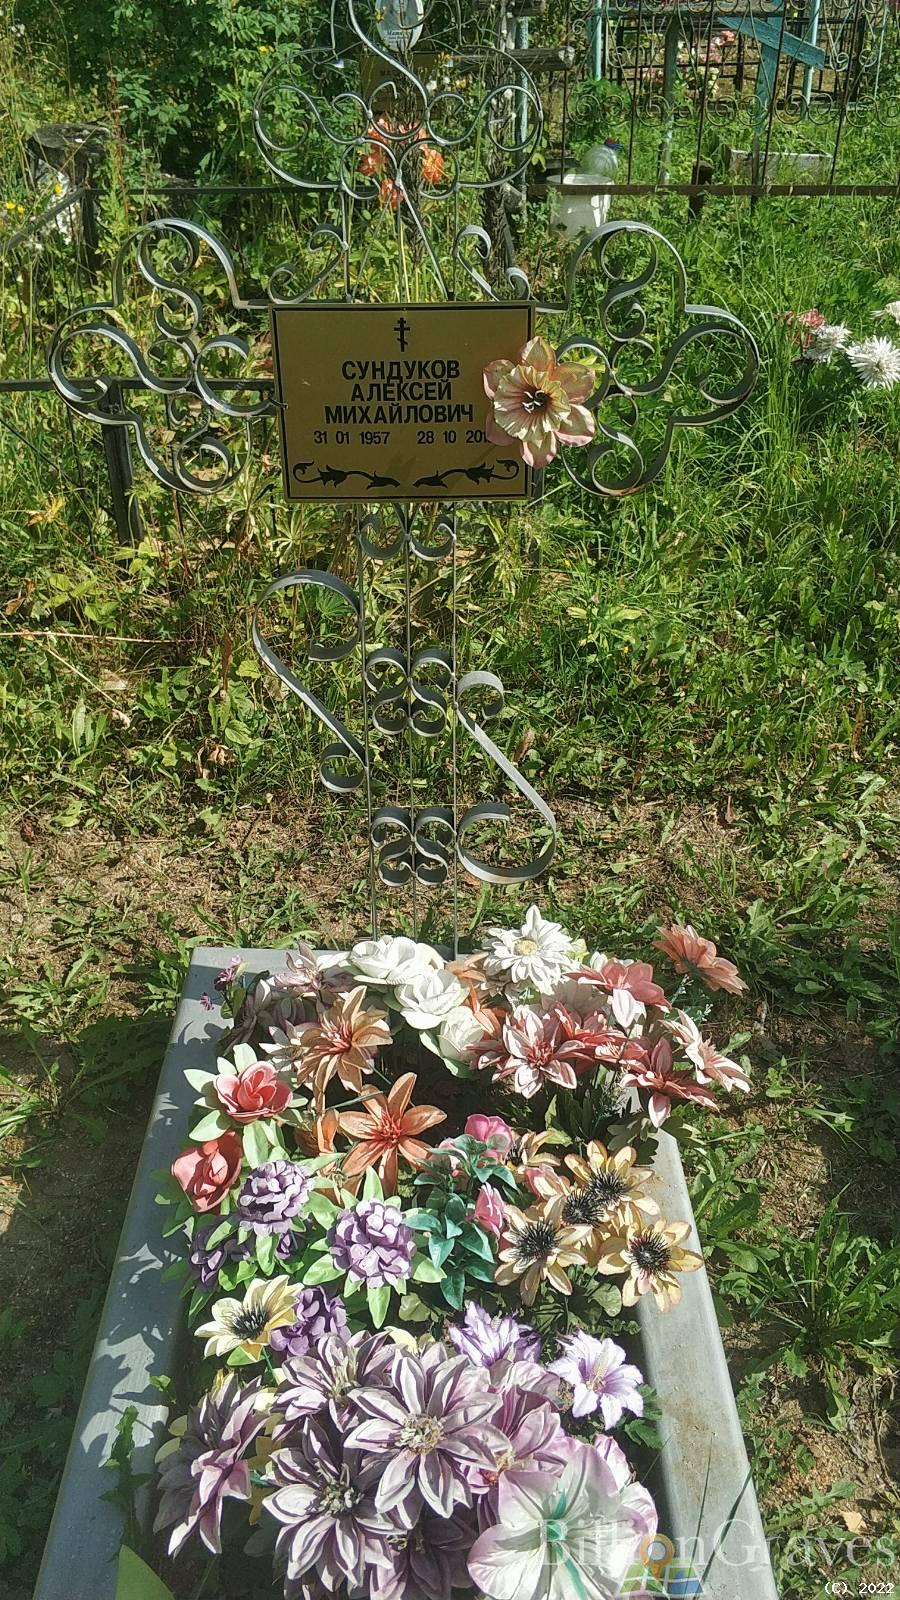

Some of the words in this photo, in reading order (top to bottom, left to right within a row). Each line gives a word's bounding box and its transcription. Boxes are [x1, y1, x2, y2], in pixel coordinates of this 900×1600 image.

[342, 359, 460, 382] СУНДУКОВ
[350, 379, 452, 401] АЛЕКСЕЙ
[324, 402, 473, 424] МИХАЙЛОВИЧ
[313, 430, 328, 444] 31
[335, 430, 350, 444] 01
[360, 431, 390, 444] 1957
[417, 430, 434, 444] 28
[443, 430, 456, 444] 10
[465, 429, 492, 444] 201
